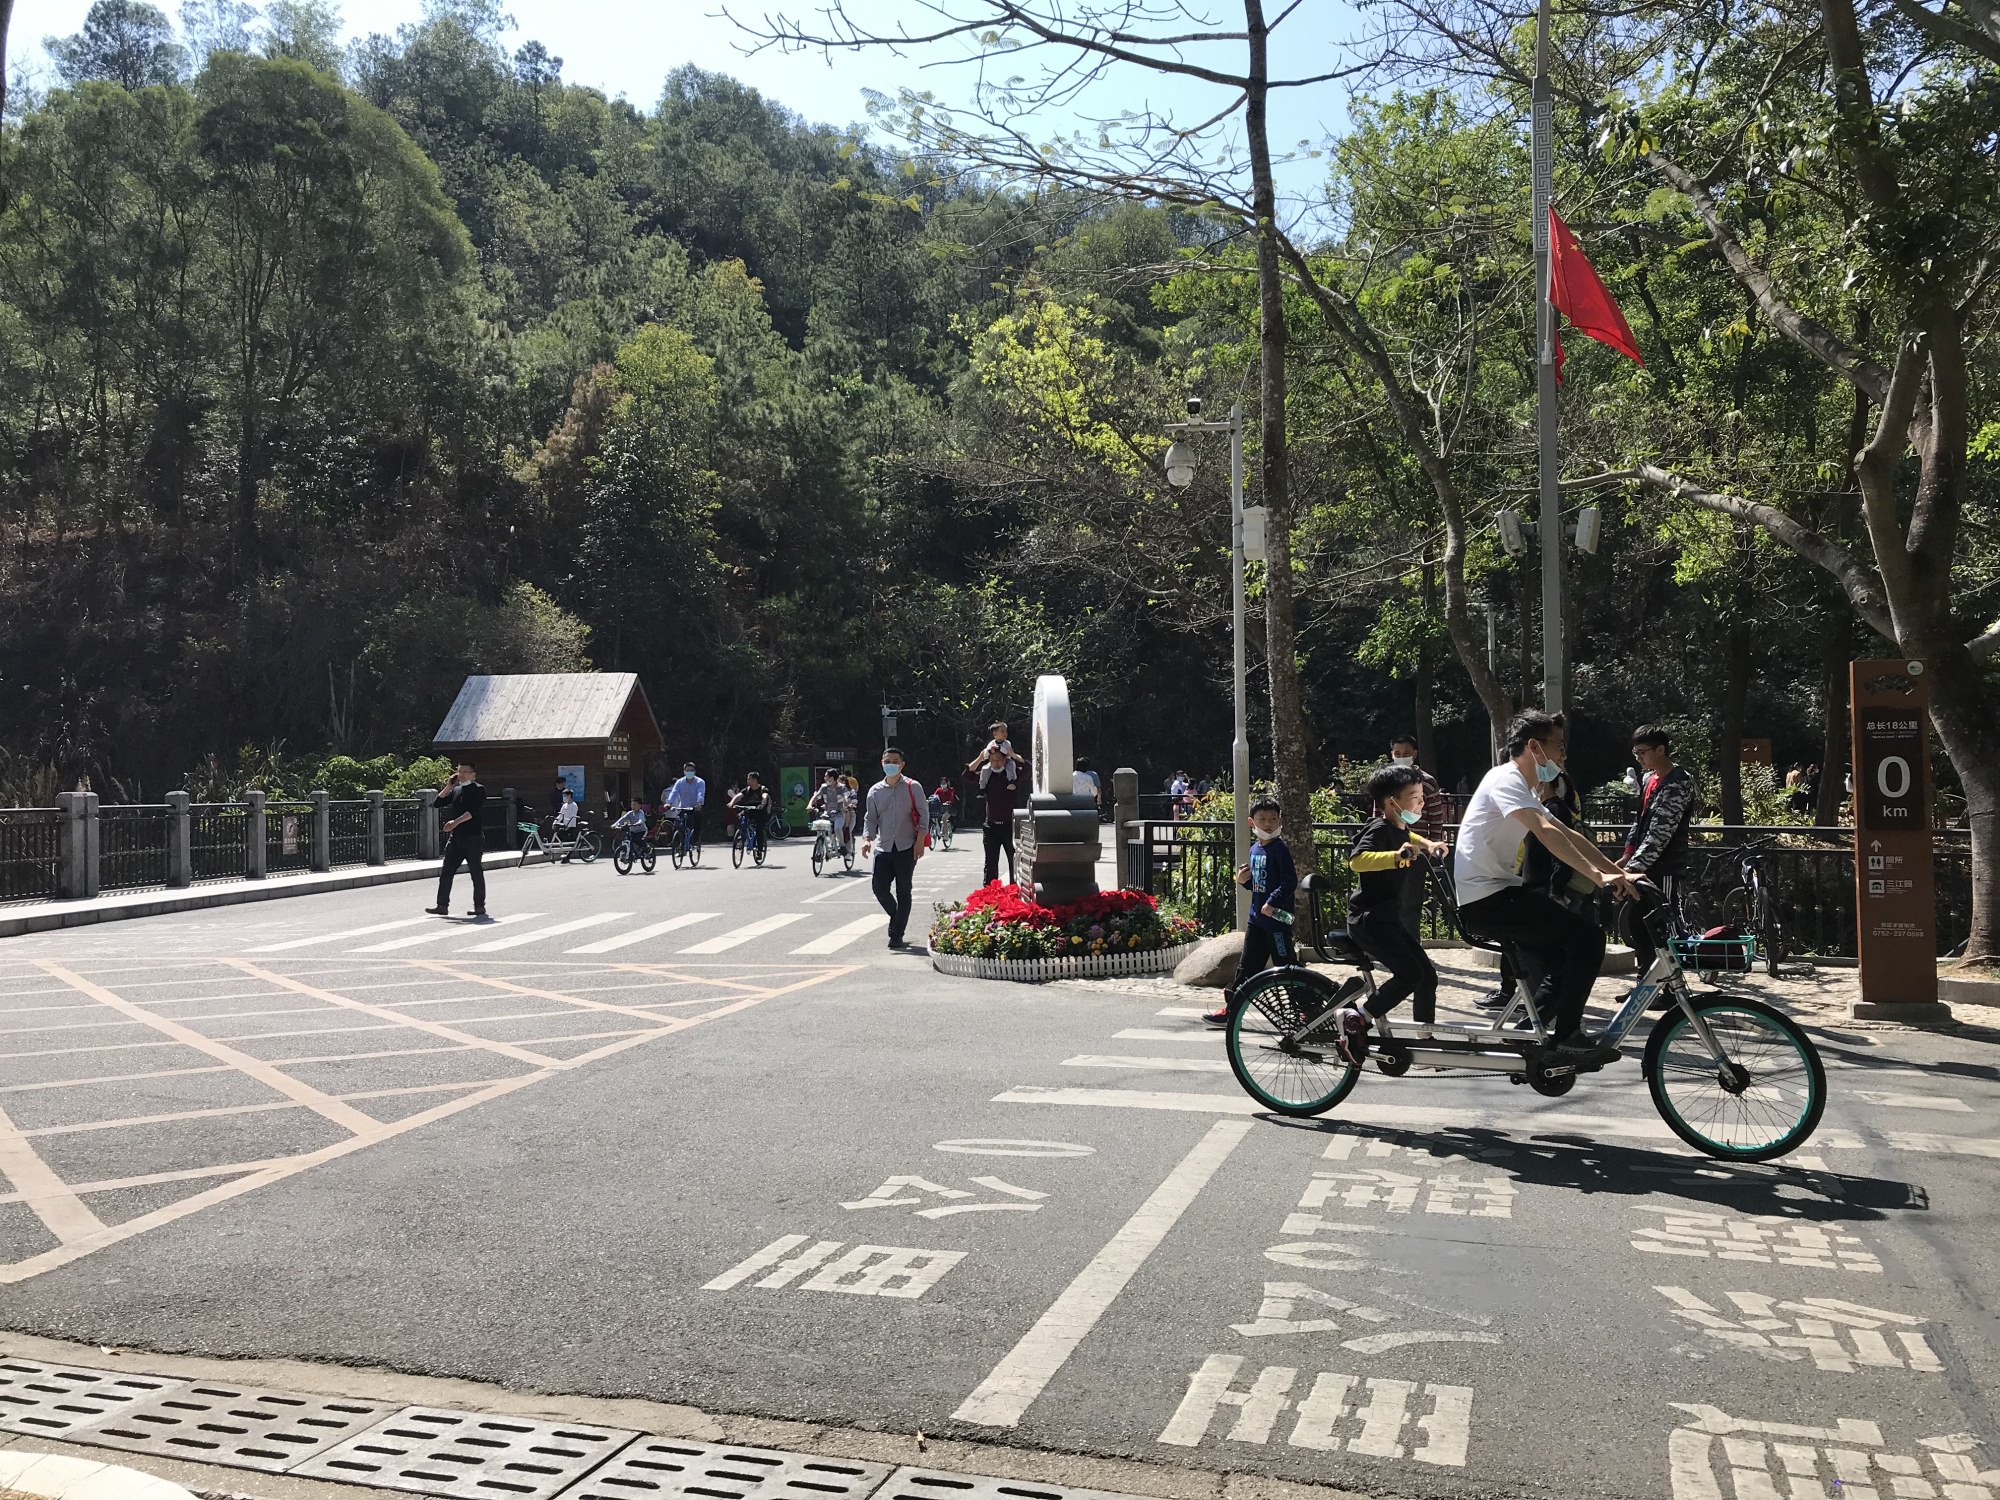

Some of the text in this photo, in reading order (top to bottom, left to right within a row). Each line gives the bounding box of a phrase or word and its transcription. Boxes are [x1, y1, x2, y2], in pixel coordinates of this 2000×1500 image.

[1867, 721, 1918, 730] 总长18公里
[1877, 756, 1911, 798] 0
[1883, 805, 1908, 817] km
